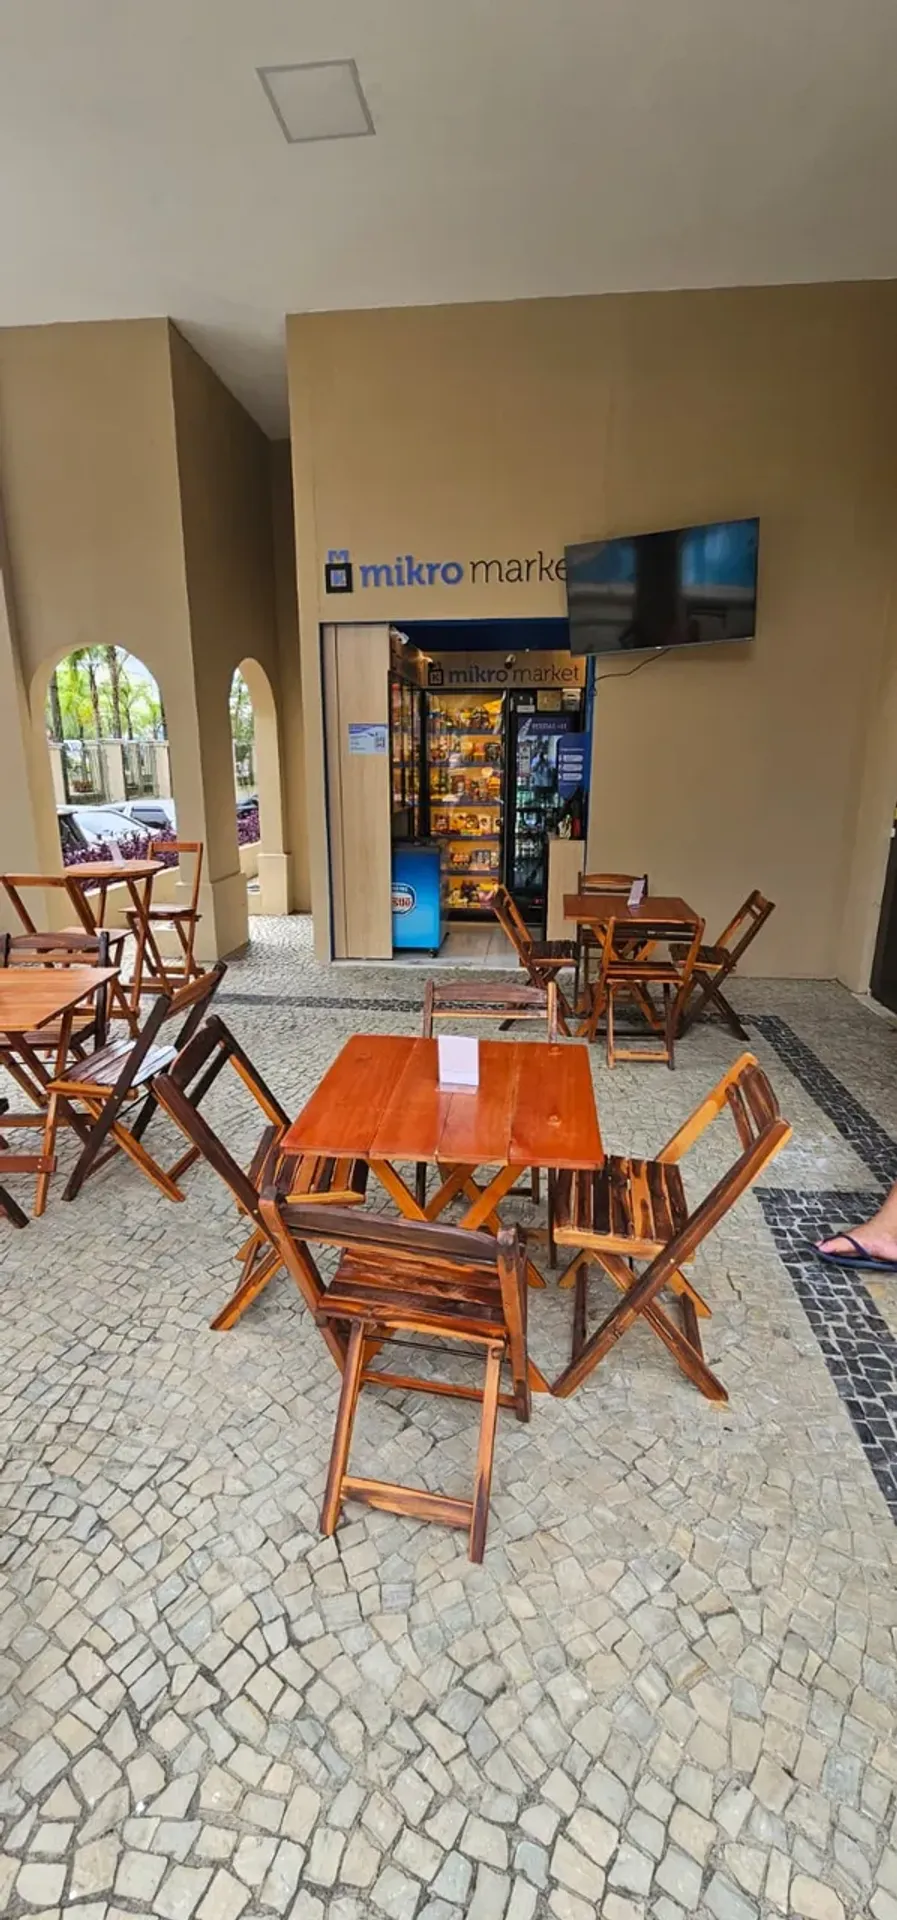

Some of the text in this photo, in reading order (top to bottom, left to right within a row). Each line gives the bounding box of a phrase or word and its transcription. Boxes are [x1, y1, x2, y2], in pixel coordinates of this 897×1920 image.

[359, 550, 567, 588] mikro marke
[450, 663, 579, 683] mikro market
